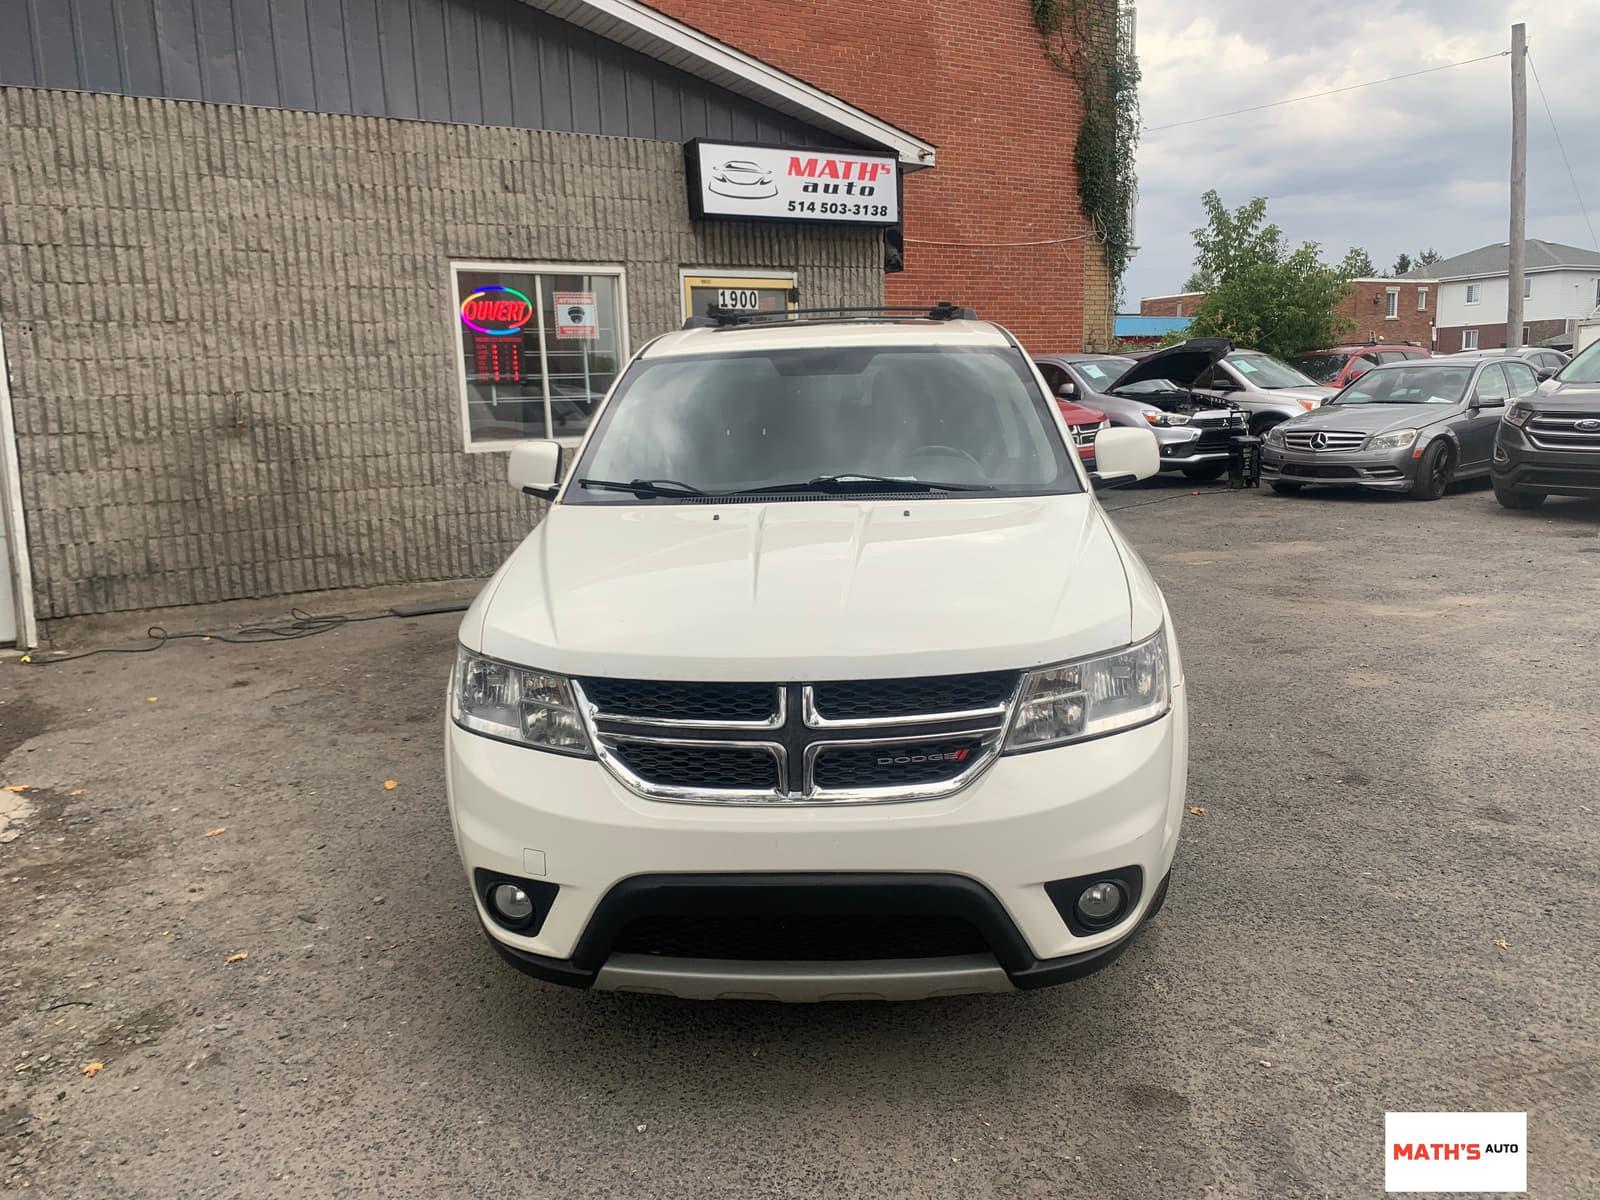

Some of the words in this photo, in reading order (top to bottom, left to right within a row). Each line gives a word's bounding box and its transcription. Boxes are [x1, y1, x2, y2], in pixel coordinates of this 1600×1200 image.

[802, 181, 875, 197] auto
[787, 200, 816, 213] 514
[820, 202, 888, 217] 503-3138
[720, 290, 757, 309] 1900
[465, 301, 527, 321] OUVERT
[877, 752, 959, 765] DODGE
